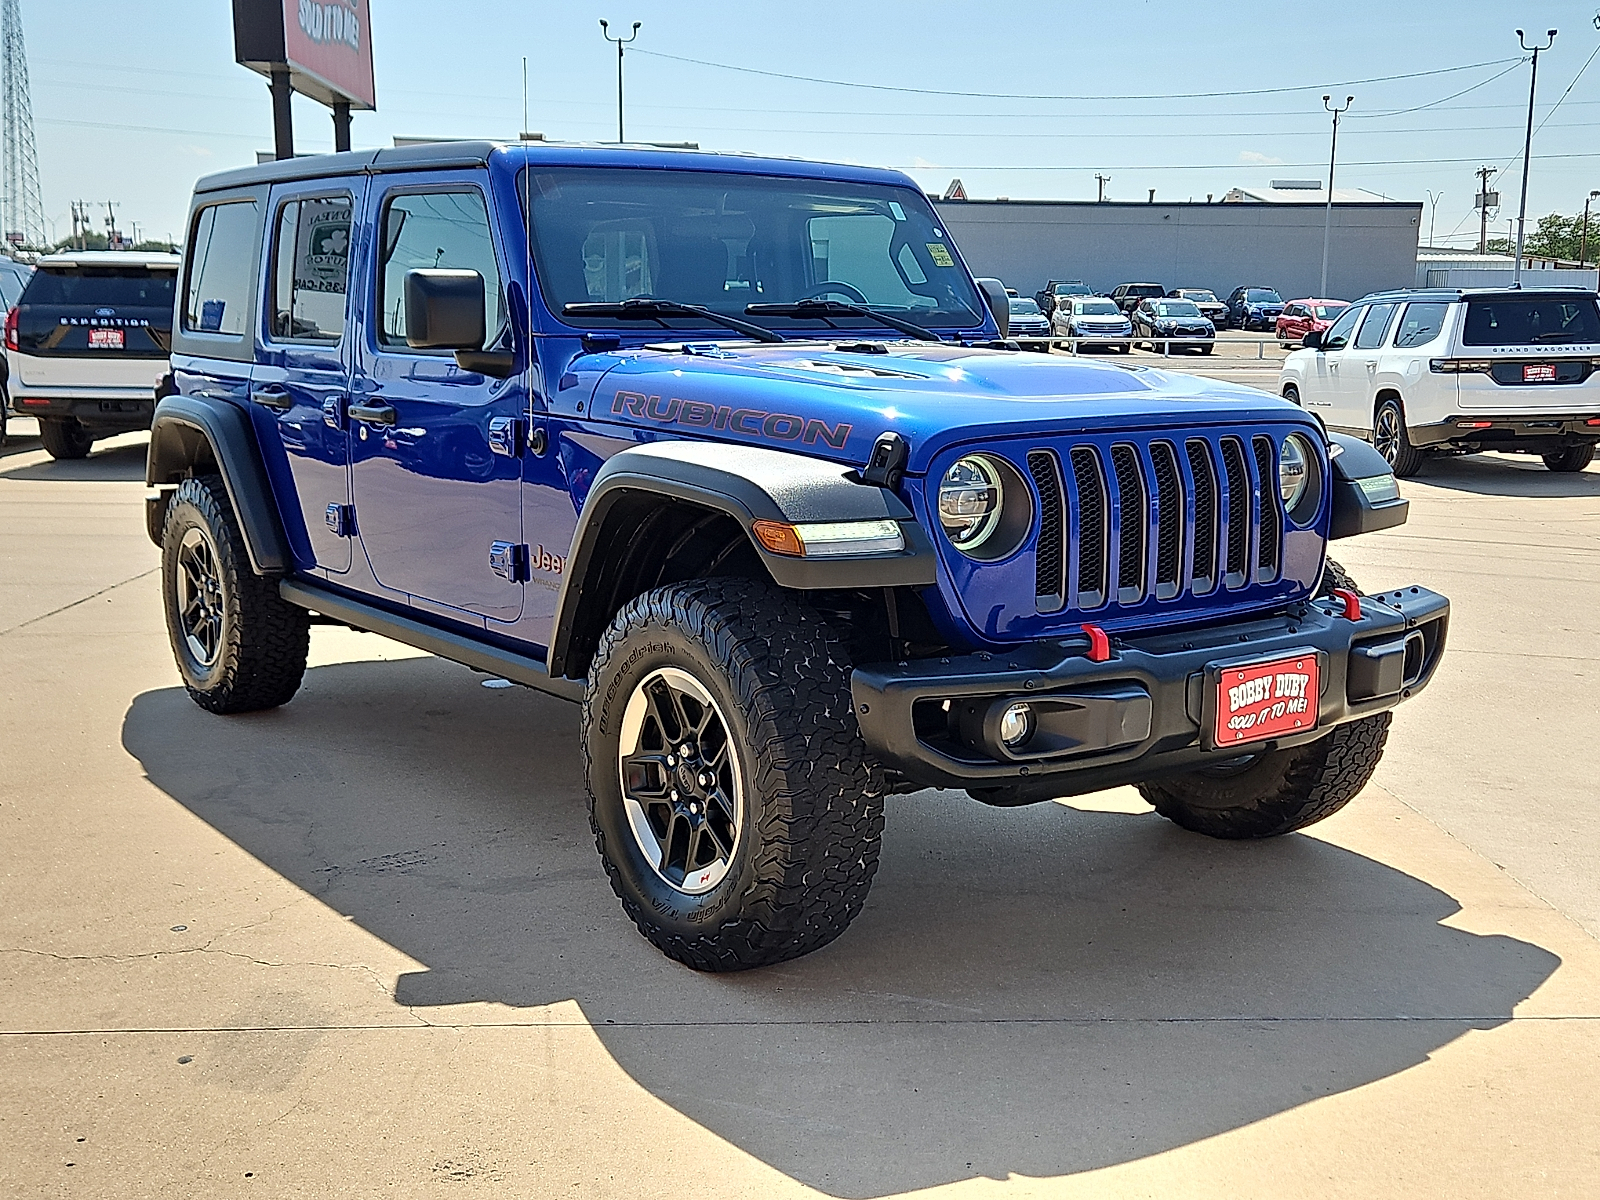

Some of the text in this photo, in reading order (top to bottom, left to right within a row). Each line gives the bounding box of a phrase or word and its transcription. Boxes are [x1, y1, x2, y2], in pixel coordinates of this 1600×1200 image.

[298, 0, 360, 50] SOLD IT TO ME!
[60, 318, 150, 327] EXPEDITION
[611, 391, 853, 450] RUBICON
[598, 641, 676, 735] BFGoodrich
[1228, 673, 1310, 713] BOBBY DUBY
[1227, 697, 1308, 730] SOLD IT TO ME!
